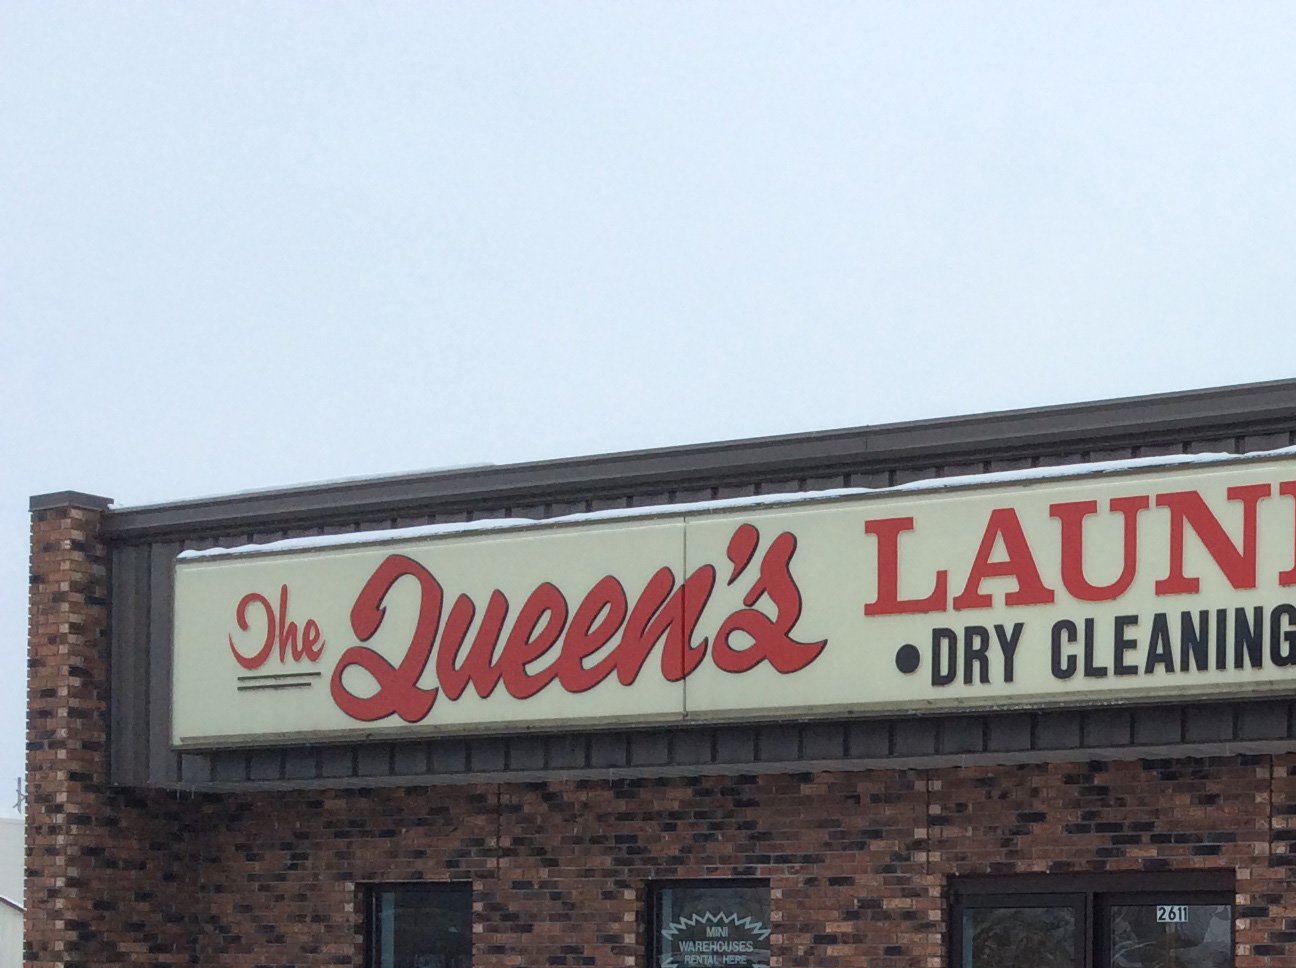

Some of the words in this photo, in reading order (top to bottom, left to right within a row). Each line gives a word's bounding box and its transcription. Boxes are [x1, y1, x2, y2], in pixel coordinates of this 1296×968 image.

[229, 584, 326, 670] The
[331, 524, 828, 722] Queen's
[931, 622, 1025, 686] DRY
[1158, 907, 1188, 920] 2611
[706, 926, 728, 937] MINI
[679, 941, 753, 952] WAREHOUSES
[684, 955, 719, 965] RENTAL
[723, 955, 747, 965] HERE
